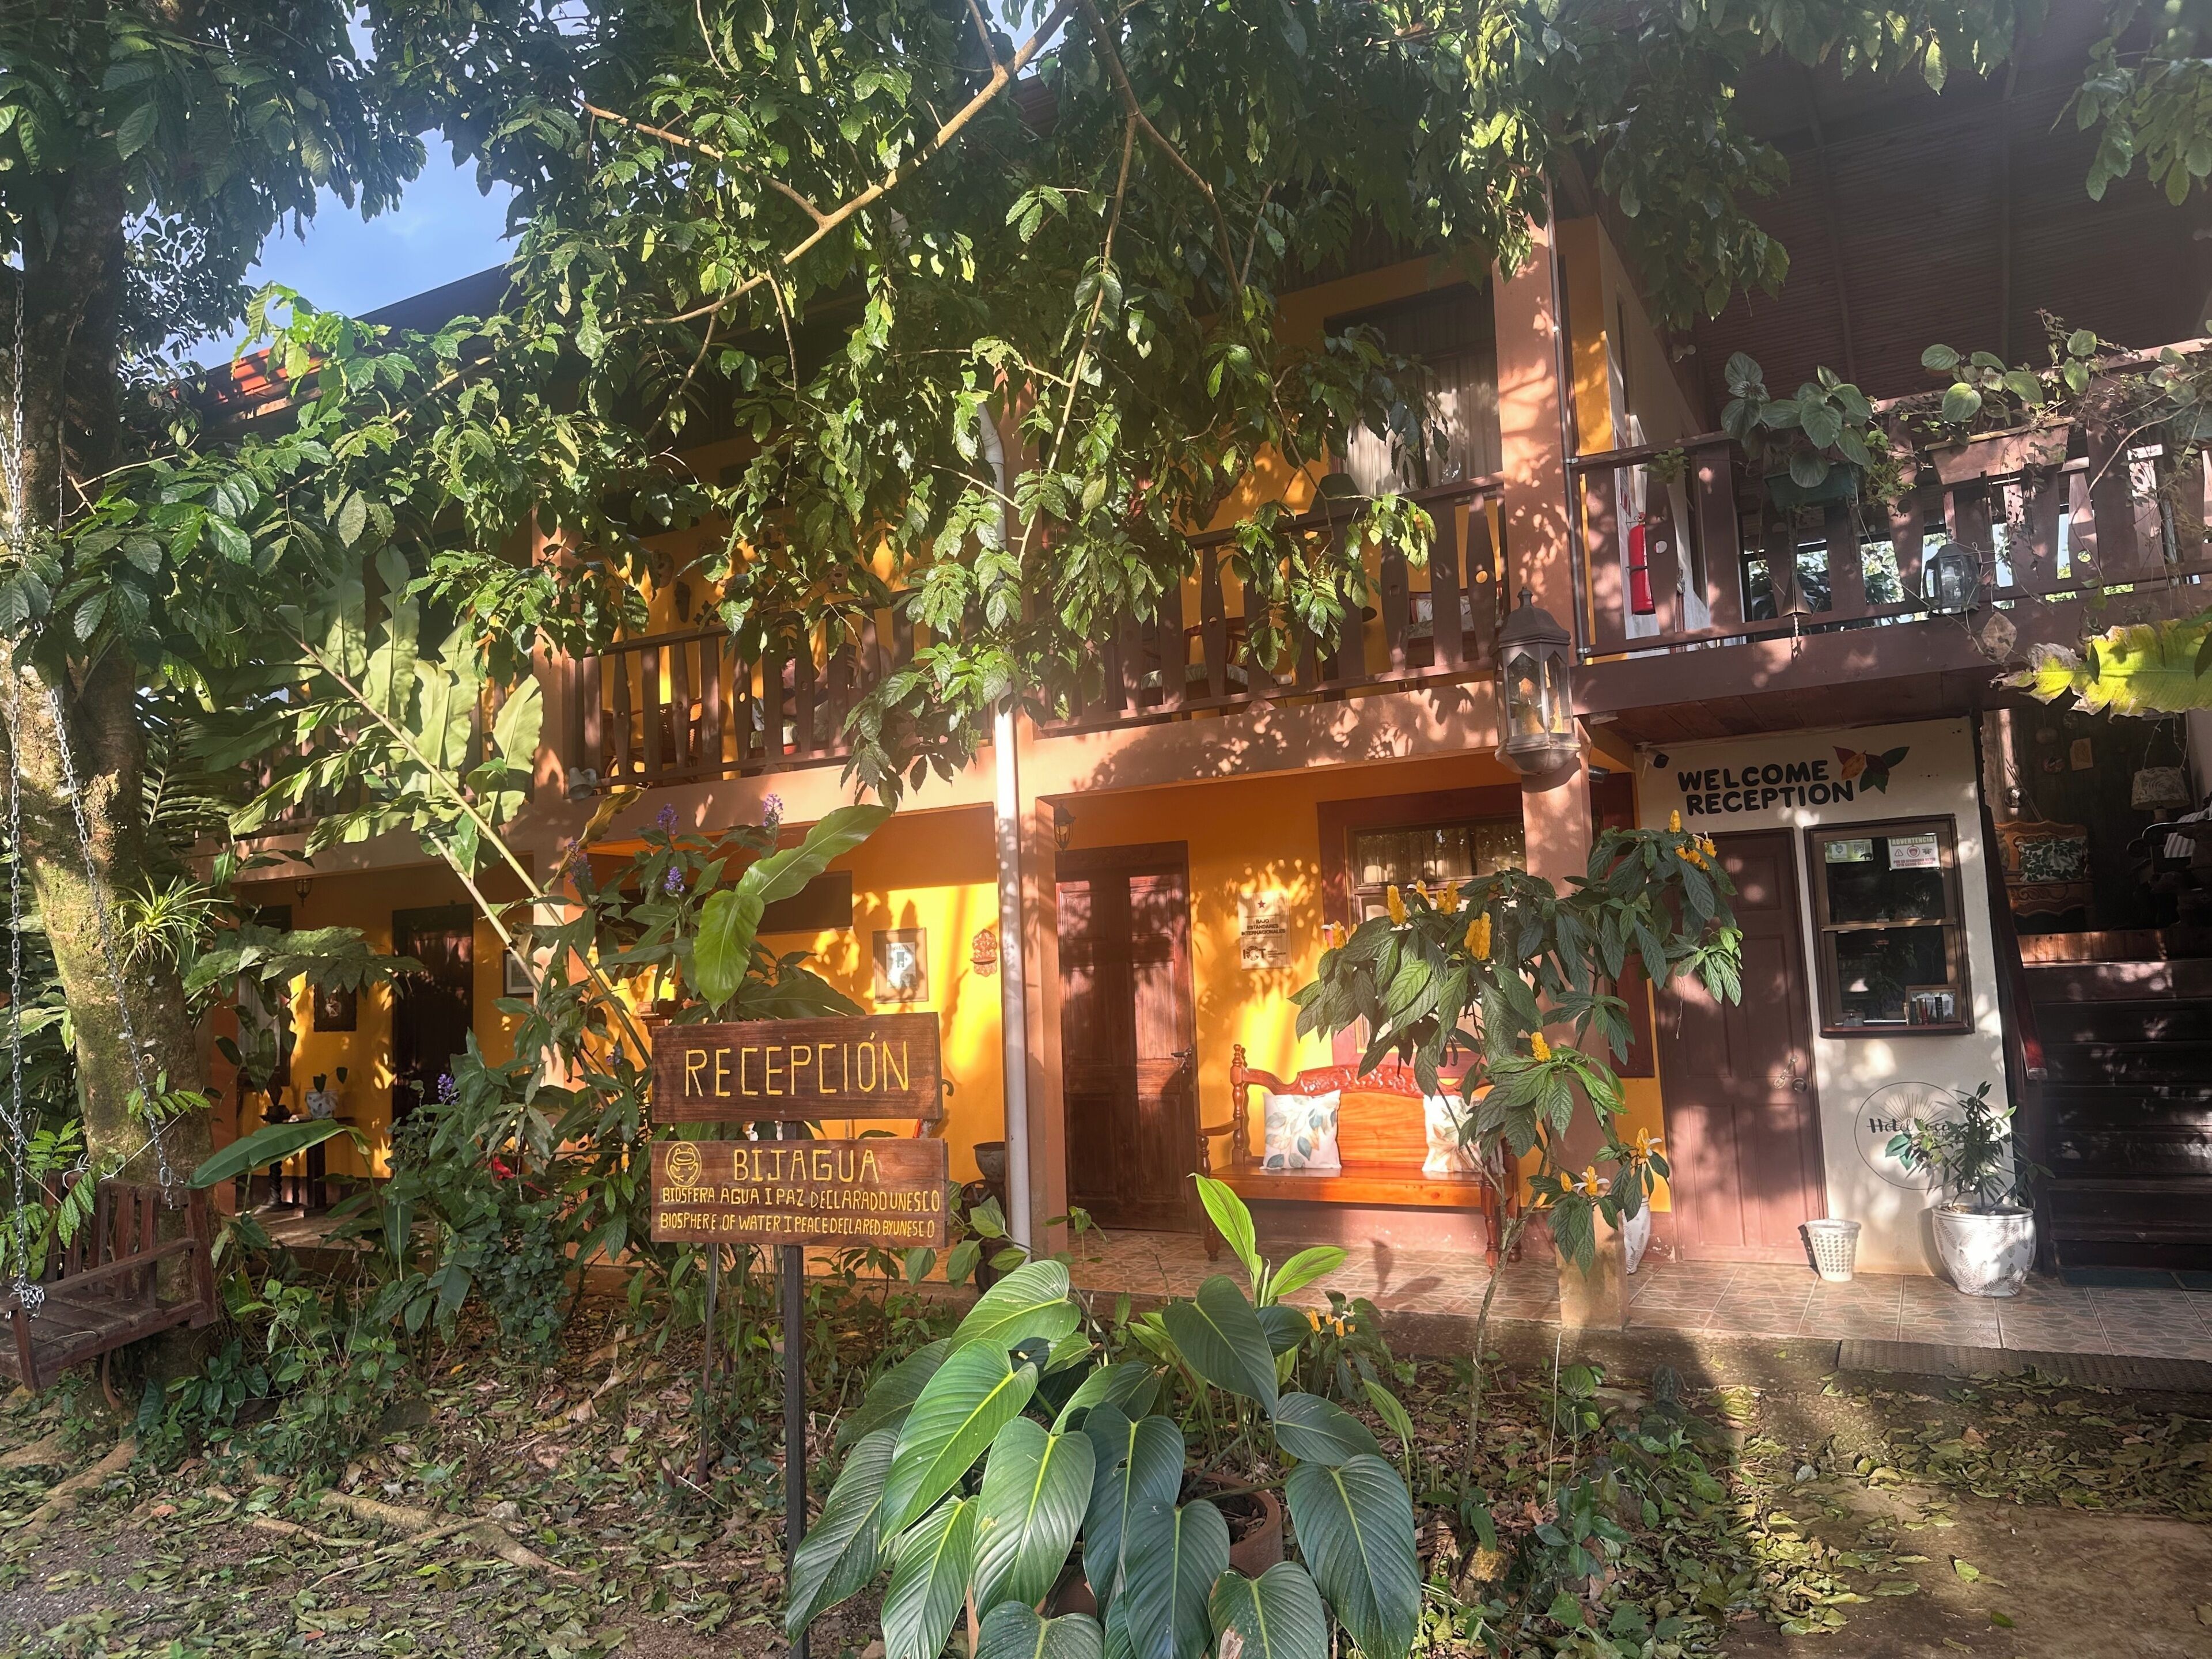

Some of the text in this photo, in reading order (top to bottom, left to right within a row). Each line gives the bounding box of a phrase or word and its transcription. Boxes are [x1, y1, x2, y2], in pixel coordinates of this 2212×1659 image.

[1677, 760, 1830, 793] WELCOME
[1686, 780, 1854, 816] RECEPTION
[1892, 836, 1934, 846] ADVERTENCIA
[685, 1032, 910, 1097] RECEPCIÓN
[1866, 1118, 1912, 1133] Hotel
[734, 1149, 880, 1183] BIJAGUA
[662, 1187, 715, 1203] BIOSFERA
[720, 1188, 760, 1205] AGUA
[776, 1188, 804, 1207] PAZ
[810, 1190, 887, 1211] DECLARADO
[890, 1190, 940, 1212] UNESCO
[660, 1212, 717, 1230] BIOSPHERE
[722, 1214, 736, 1231] OF
[738, 1214, 781, 1231] WATER
[794, 1216, 828, 1234] PEACE
[830, 1218, 881, 1236] DECLARED
